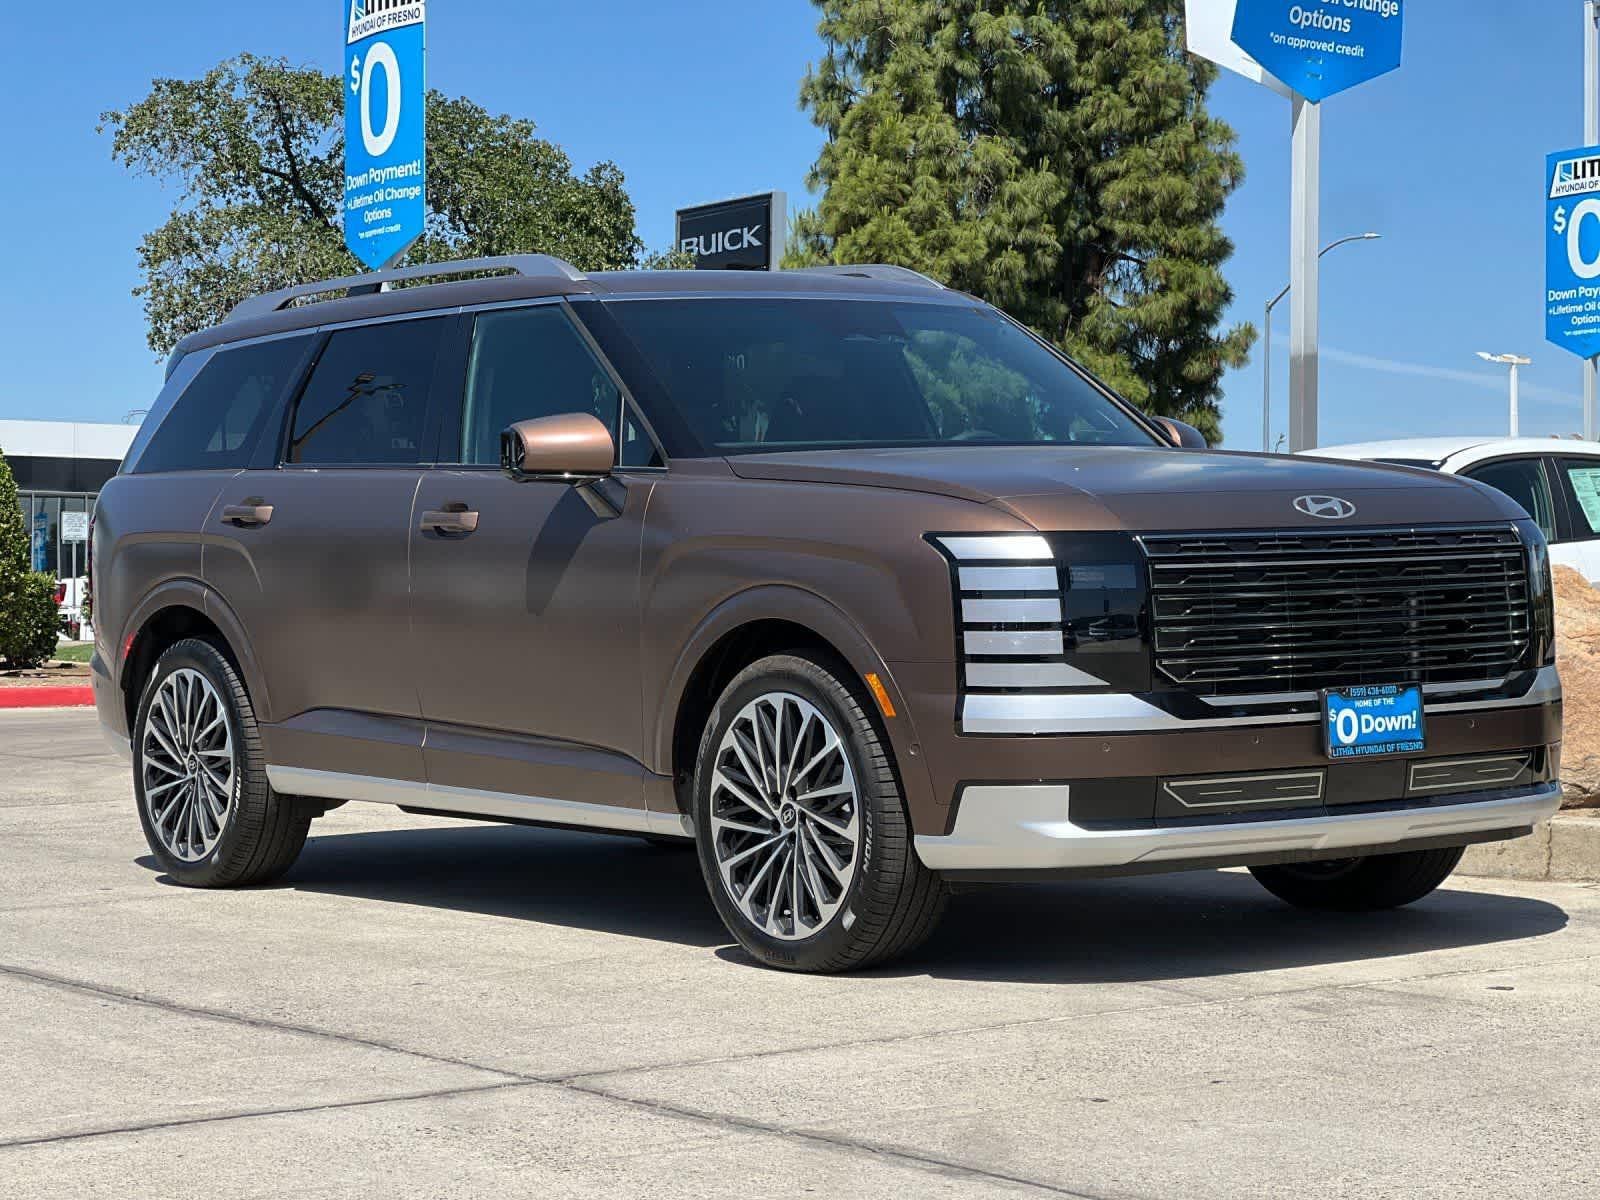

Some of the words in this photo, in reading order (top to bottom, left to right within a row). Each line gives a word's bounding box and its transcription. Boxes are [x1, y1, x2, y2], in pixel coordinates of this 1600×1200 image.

[352, 17, 376, 38] HYUNDAI
[376, 14, 387, 28] OF
[388, 7, 421, 25] FRESNO
[1289, 6, 1351, 32] Options
[1287, 36, 1334, 53] approved
[1335, 44, 1365, 57] credit
[346, 172, 368, 191] Down
[369, 160, 421, 185] Payment!
[1573, 159, 1600, 180] LIT
[374, 188, 384, 203] Oil
[385, 186, 421, 200] Change
[1555, 181, 1587, 195] HYUNDAI
[364, 207, 392, 225] Options
[681, 224, 762, 256] BUICK
[1548, 289, 1577, 302] Down
[1578, 286, 1600, 299] Pay
[1584, 301, 1596, 312] Oil
[1354, 698, 1373, 709] HOME
[1373, 698, 1383, 707] OF
[1383, 697, 1395, 705] THE
[1361, 710, 1417, 734] Down!
[1332, 746, 1354, 757] LITHIA
[1355, 743, 1386, 755] HYUNDAI
[1386, 743, 1396, 752] OF
[1396, 741, 1423, 752] FRESNO
